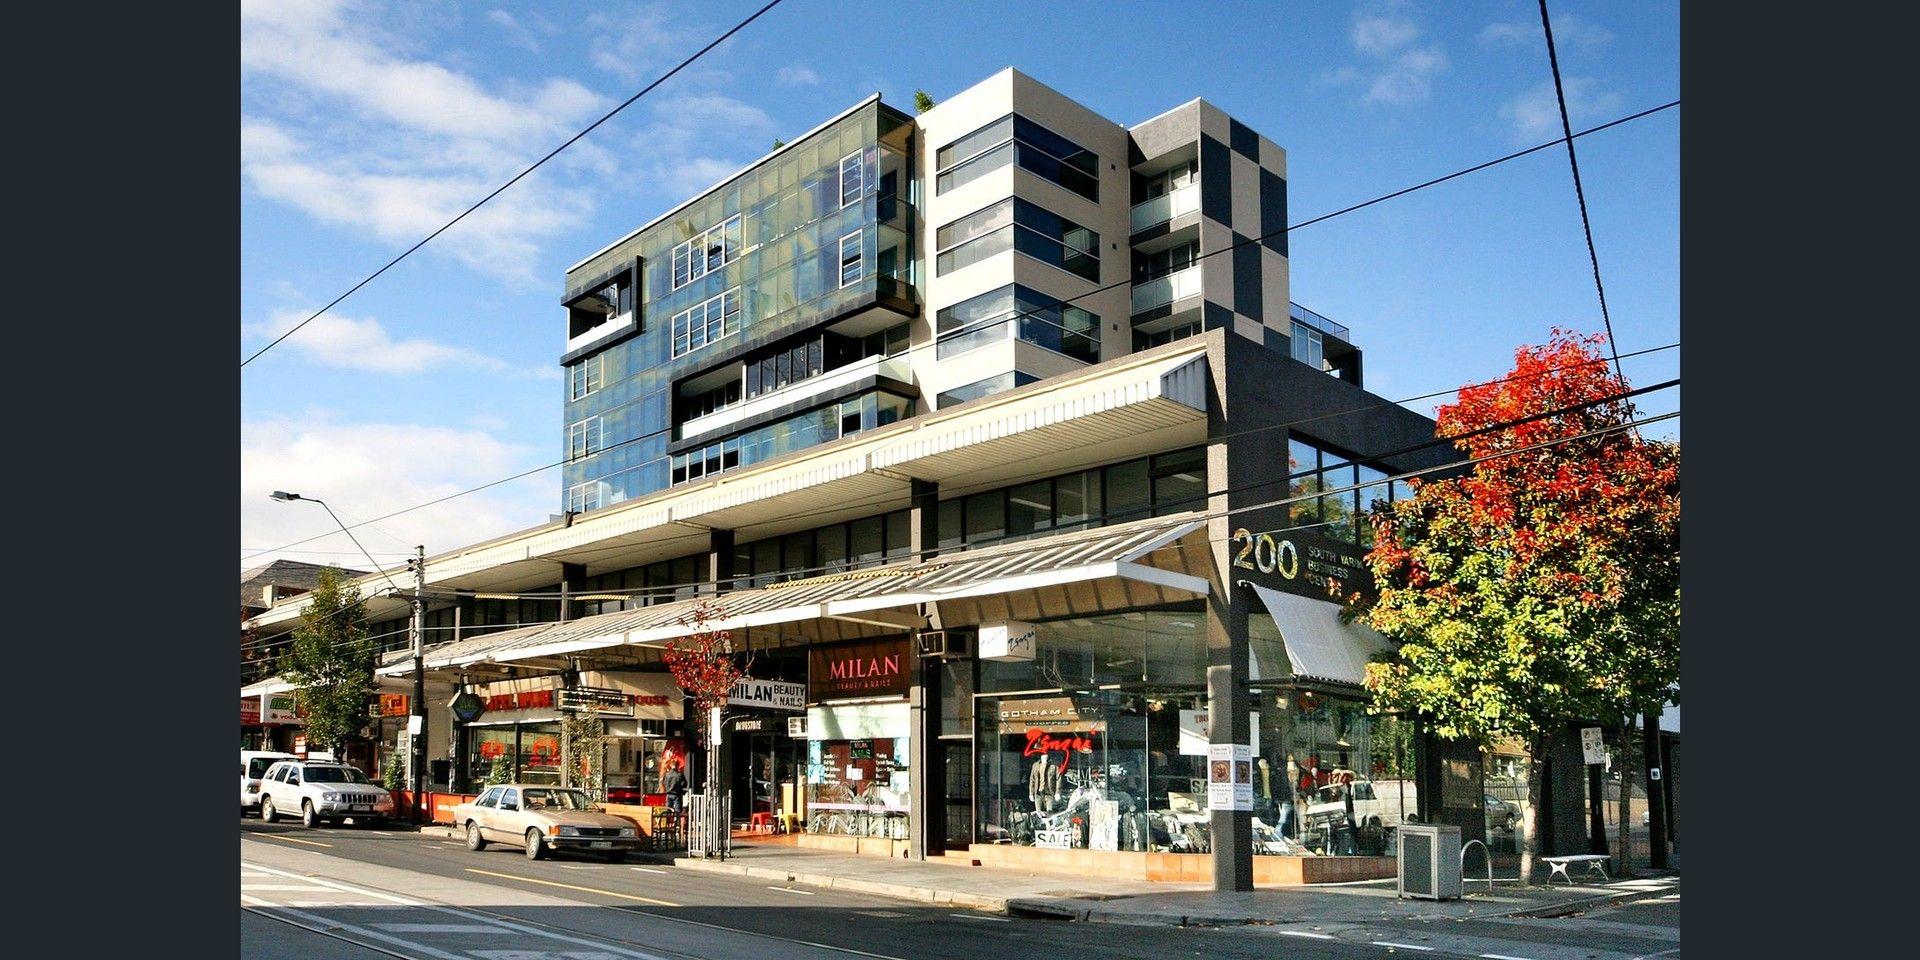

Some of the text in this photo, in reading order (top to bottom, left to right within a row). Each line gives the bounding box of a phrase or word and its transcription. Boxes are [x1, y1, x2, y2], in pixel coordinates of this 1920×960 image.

[1233, 527, 1299, 580] 200
[1308, 545, 1337, 562] SOUTH
[1308, 559, 1349, 579] BUSINESS
[830, 654, 900, 680] MILAN
[729, 683, 773, 702] MILAN
[773, 684, 805, 697] BEAUTY
[780, 697, 803, 708] NAILS
[1000, 707, 1099, 718] GOTHAM CITY
[1037, 833, 1070, 847] SALE
